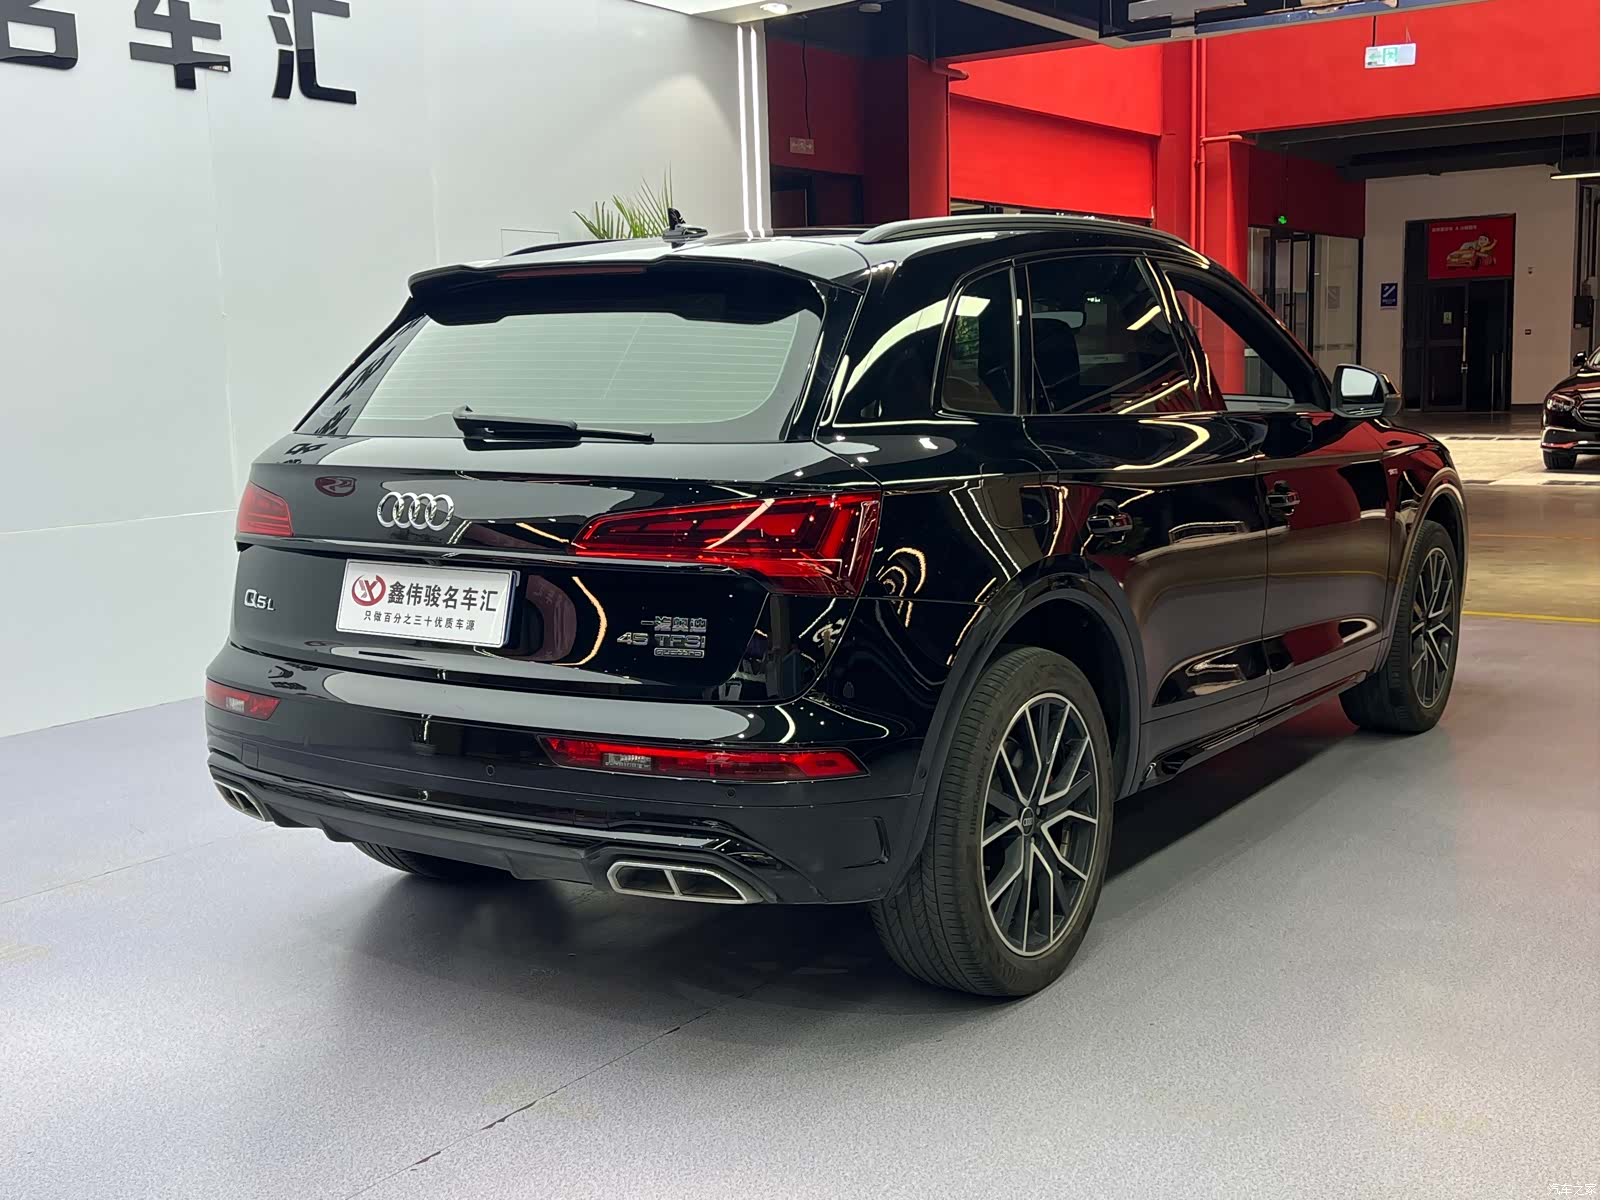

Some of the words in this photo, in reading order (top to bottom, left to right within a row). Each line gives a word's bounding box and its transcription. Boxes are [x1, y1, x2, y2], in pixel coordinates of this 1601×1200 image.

[244, 589, 275, 611] Q5L
[387, 581, 499, 612] 鑫伟骏名车汇
[363, 610, 476, 631] 只做百分之三十优质车源
[616, 632, 649, 646] 45
[654, 633, 707, 649] TFSI
